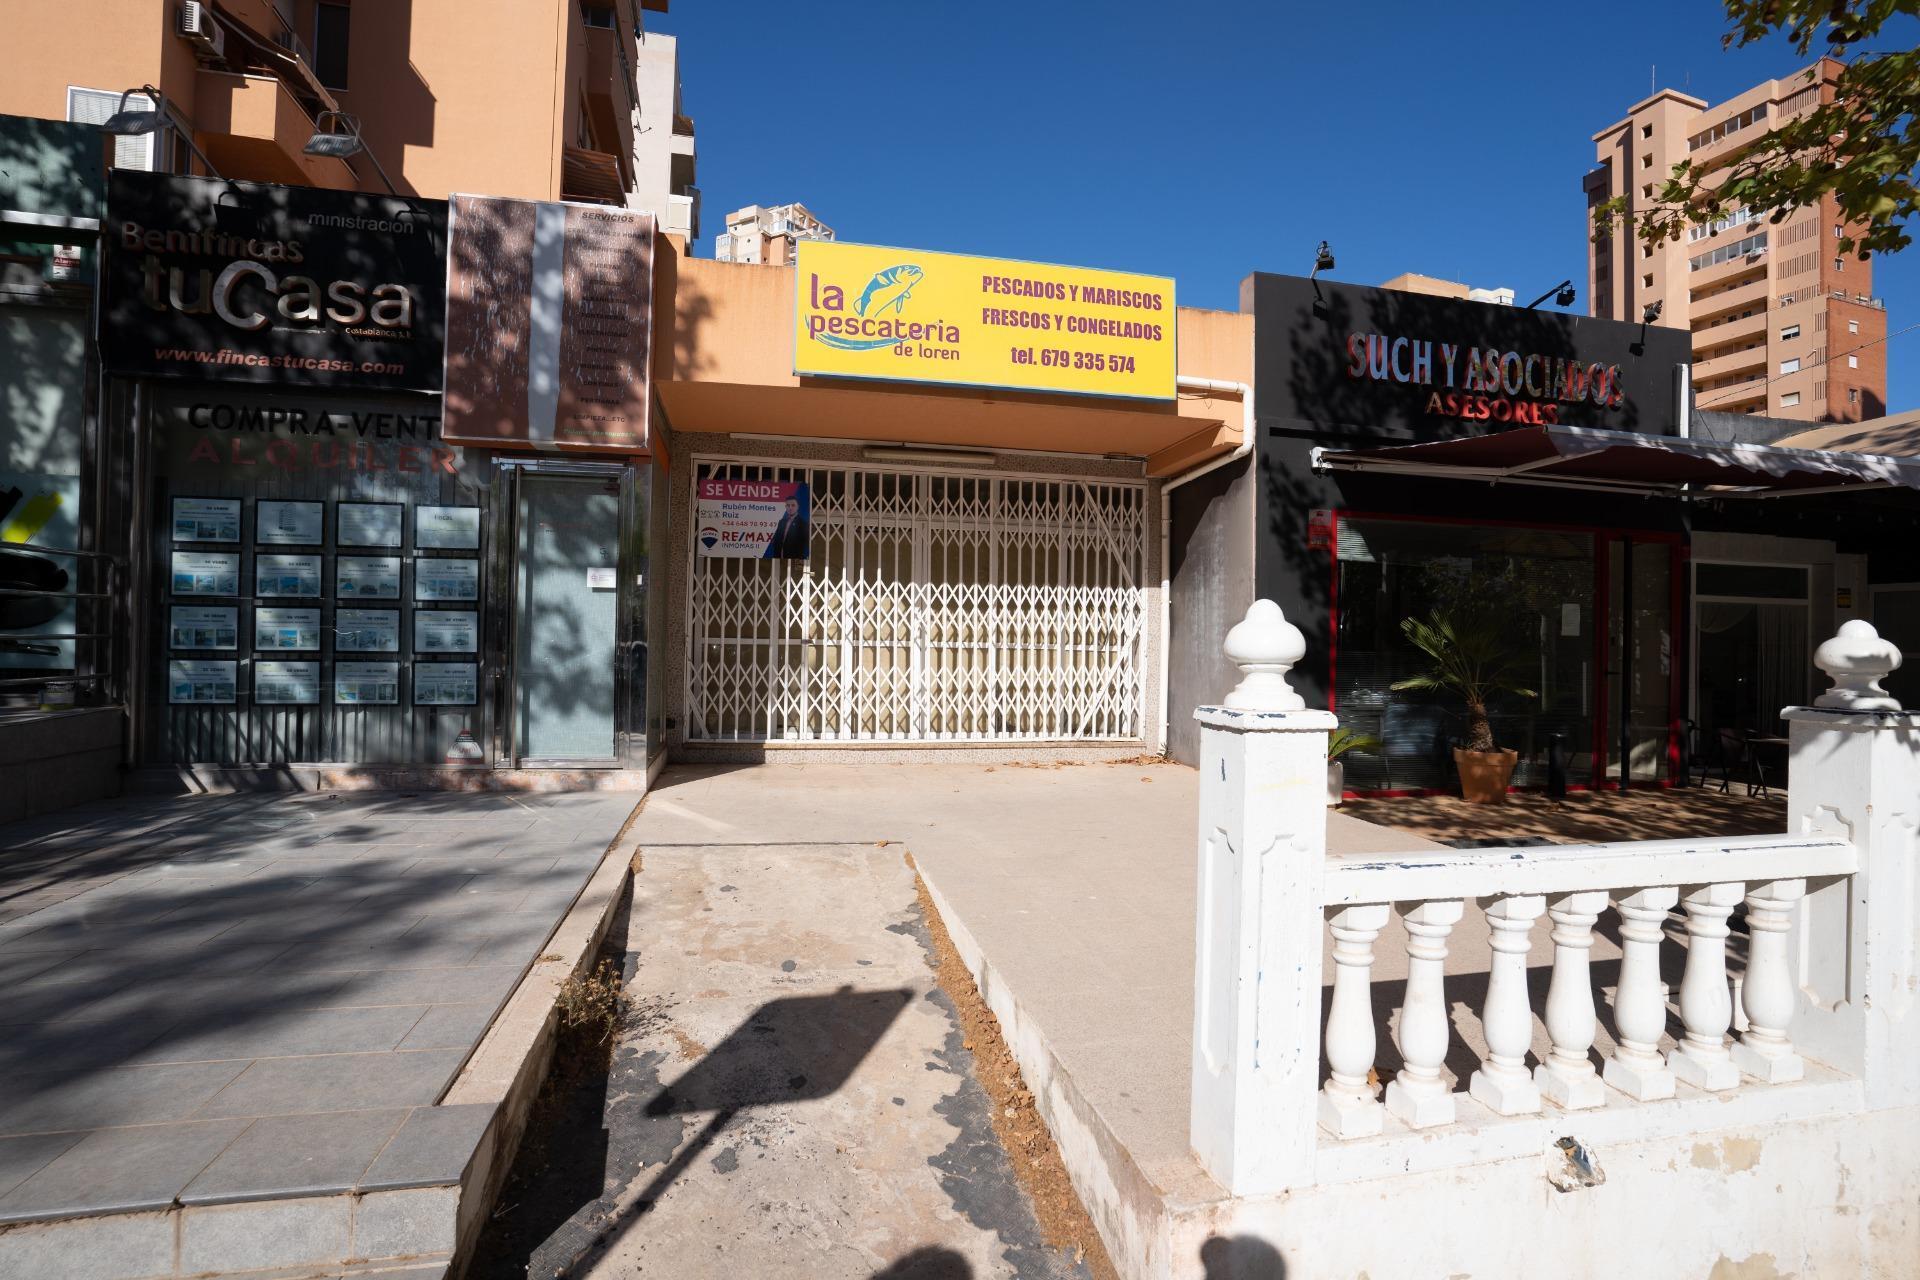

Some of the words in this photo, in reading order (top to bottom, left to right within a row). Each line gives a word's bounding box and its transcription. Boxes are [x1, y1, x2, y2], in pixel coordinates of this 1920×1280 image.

[581, 211, 635, 223] SERVICIOS
[810, 272, 844, 311] la
[982, 275, 1066, 301] PESCADOS
[1069, 285, 1079, 302] Y
[1082, 286, 1163, 312] MARISCOS
[809, 313, 961, 345] pescateria
[982, 308, 1051, 331] FRESCOS
[1054, 313, 1064, 332] Y
[1066, 316, 1163, 342] CONGELADOS
[154, 347, 405, 375] www.fincastucasa.com
[894, 341, 914, 358] de
[918, 344, 961, 362] loren
[1011, 346, 1038, 366] tel.
[1040, 348, 1070, 369] 679
[1073, 351, 1105, 372] 335
[1108, 354, 1136, 374] 574
[1347, 331, 1432, 386] SUCH
[1439, 343, 1459, 388] Y
[1462, 346, 1625, 410] ASOCIADOS
[188, 403, 444, 442] COMPRA-VENT
[1425, 391, 1560, 426] ASESORES
[188, 434, 459, 475] ALQUILER
[706, 483, 724, 496] SE
[728, 484, 780, 499] VENDE
[722, 503, 747, 511] Rubén
[748, 504, 777, 512] Montes
[722, 511, 740, 519] Ruiz
[721, 531, 774, 544] RE/MAX
